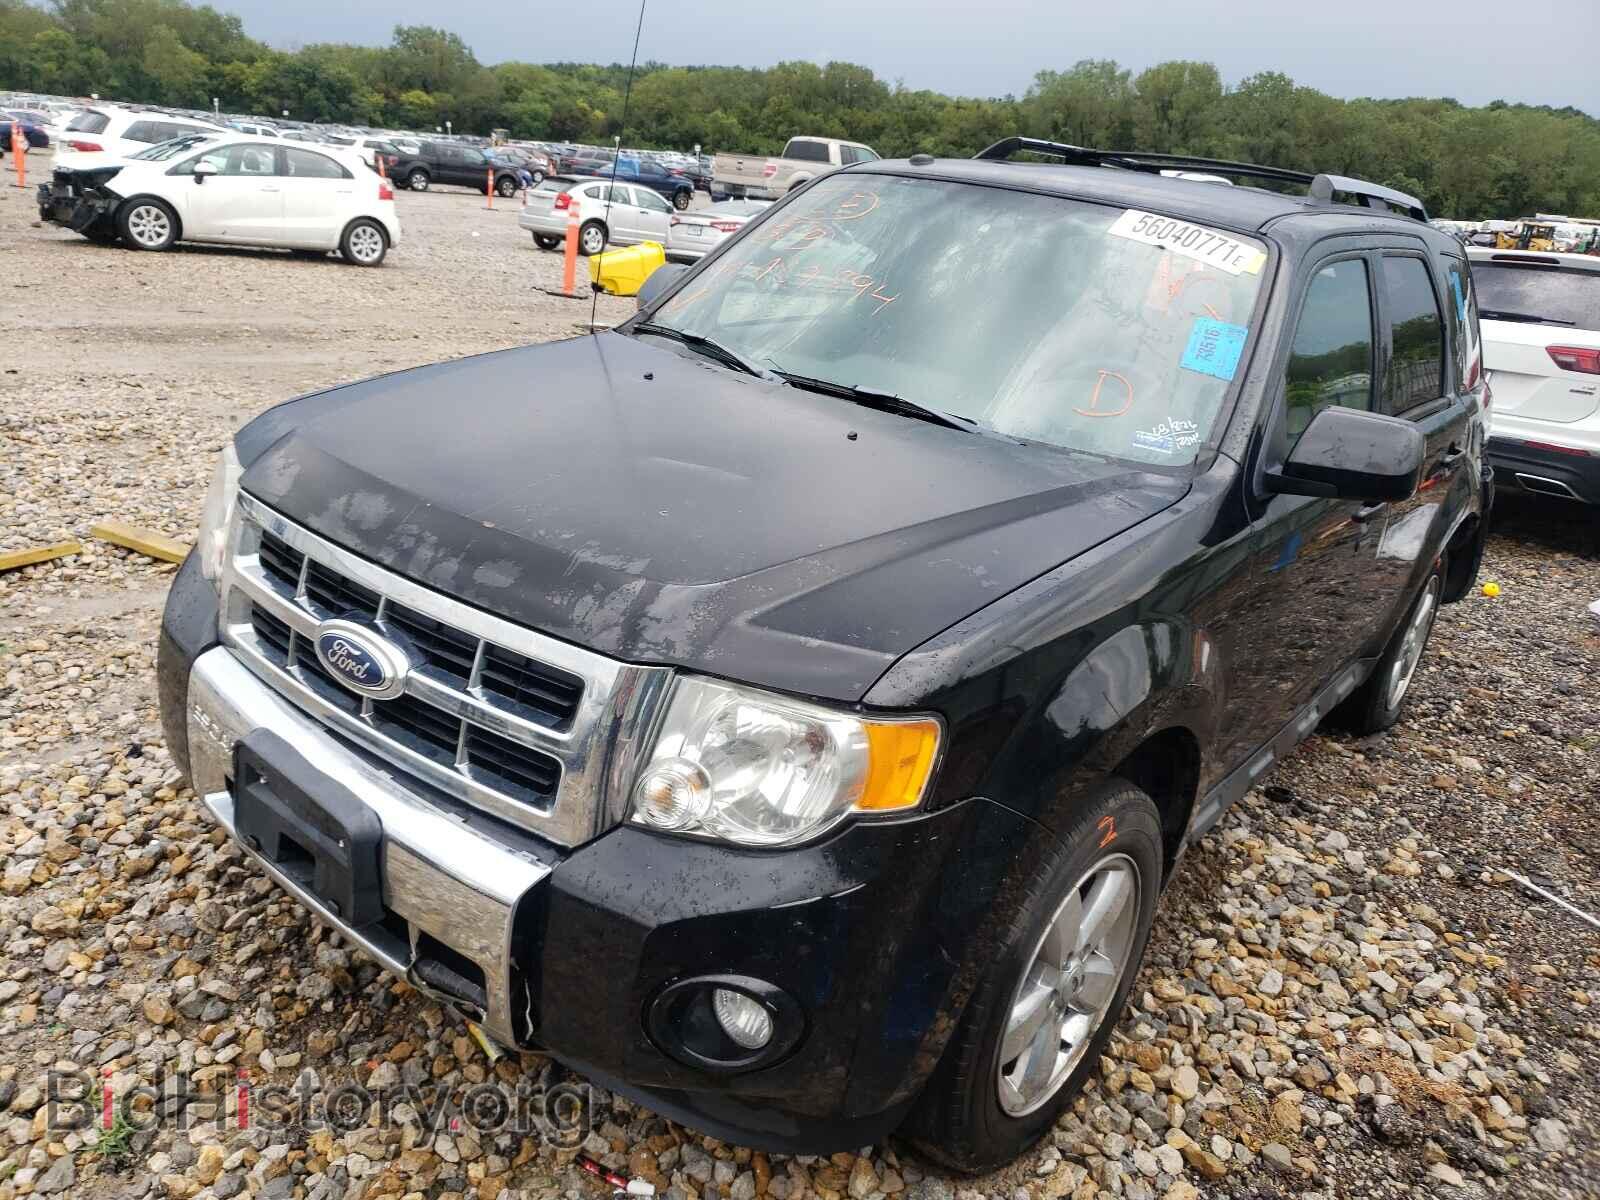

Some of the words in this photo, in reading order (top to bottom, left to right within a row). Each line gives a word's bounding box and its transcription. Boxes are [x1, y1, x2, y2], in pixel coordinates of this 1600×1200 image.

[1132, 214, 1240, 262] 56040771
[1072, 368, 1135, 418] D
[327, 639, 371, 679] Ford
[1096, 814, 1119, 849] 2
